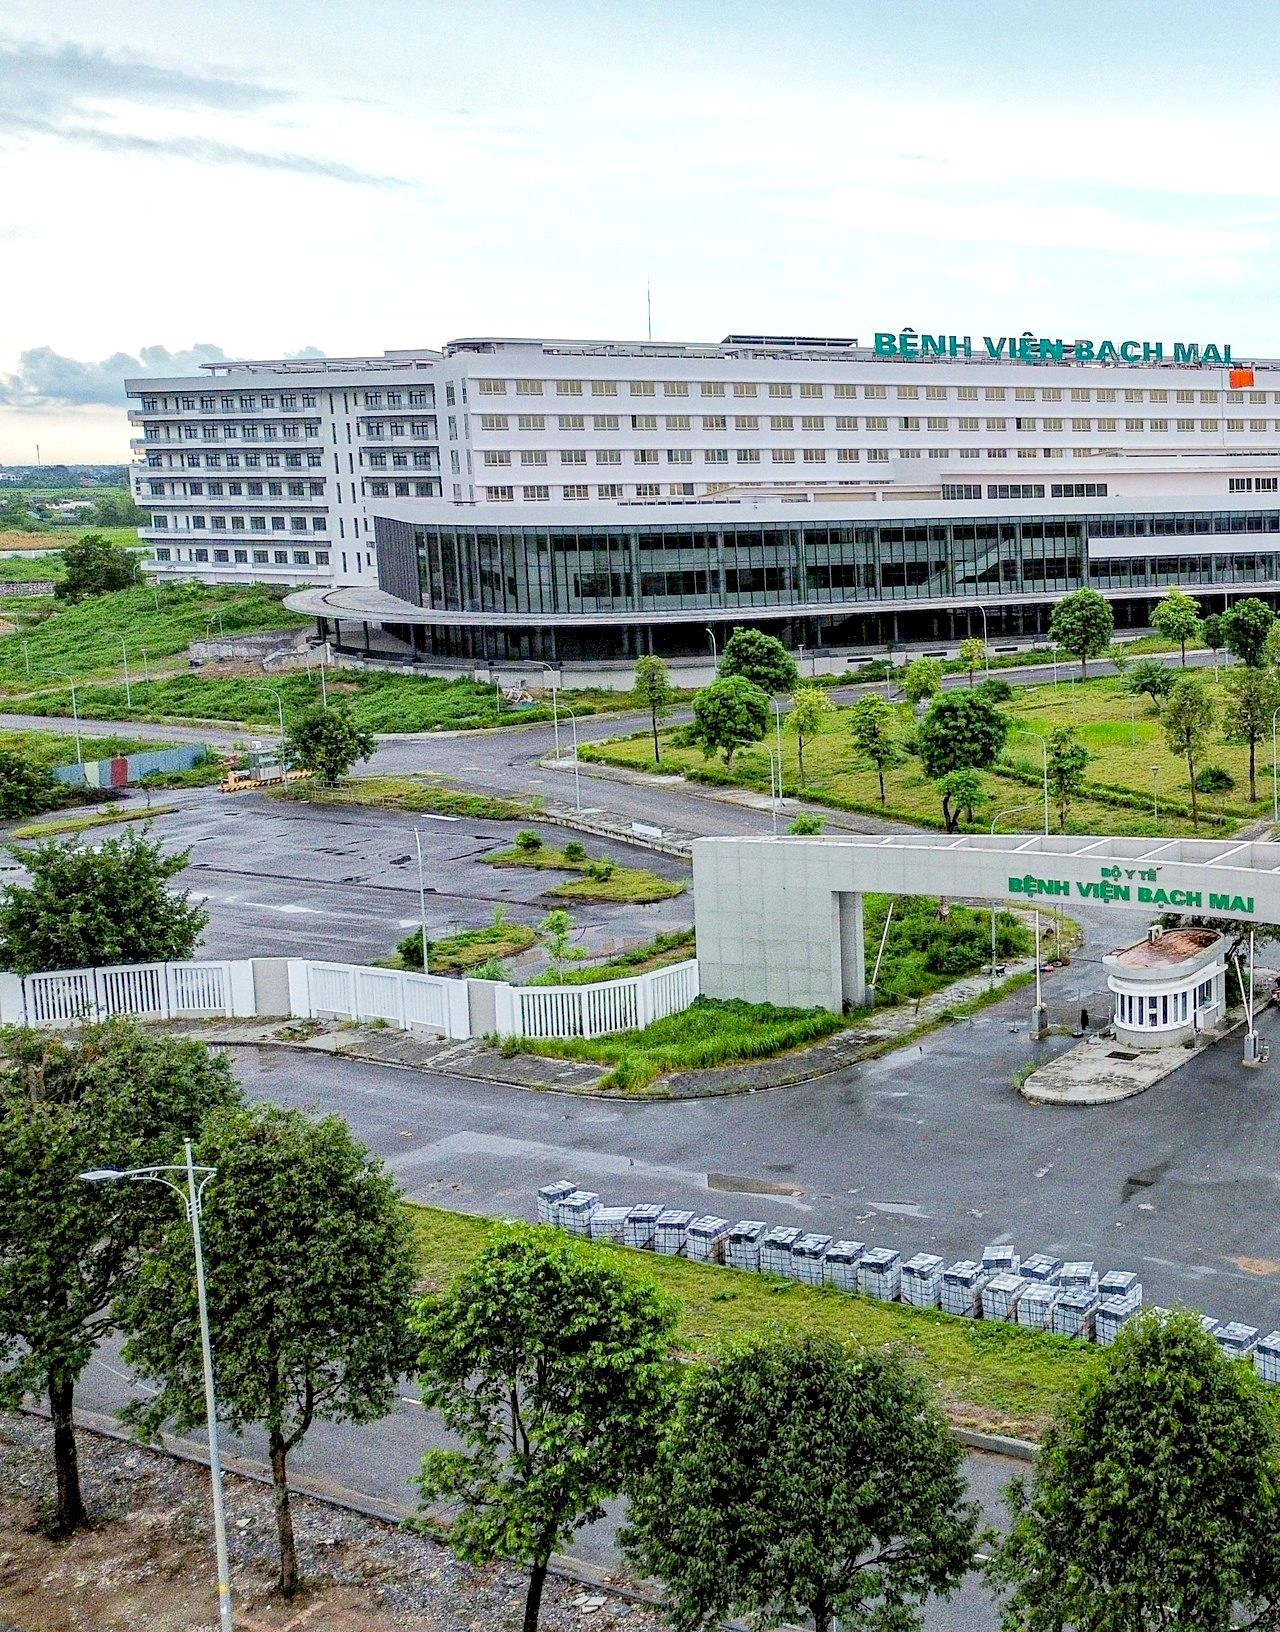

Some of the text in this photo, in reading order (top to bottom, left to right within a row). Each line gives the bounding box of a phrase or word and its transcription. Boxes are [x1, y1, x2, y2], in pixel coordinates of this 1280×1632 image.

[1173, 342, 1232, 364] MAI
[1101, 865, 1163, 882] BỘ Y TẾ
[1008, 874, 1255, 913] BỆNH VIỆN BẠCH MAI
